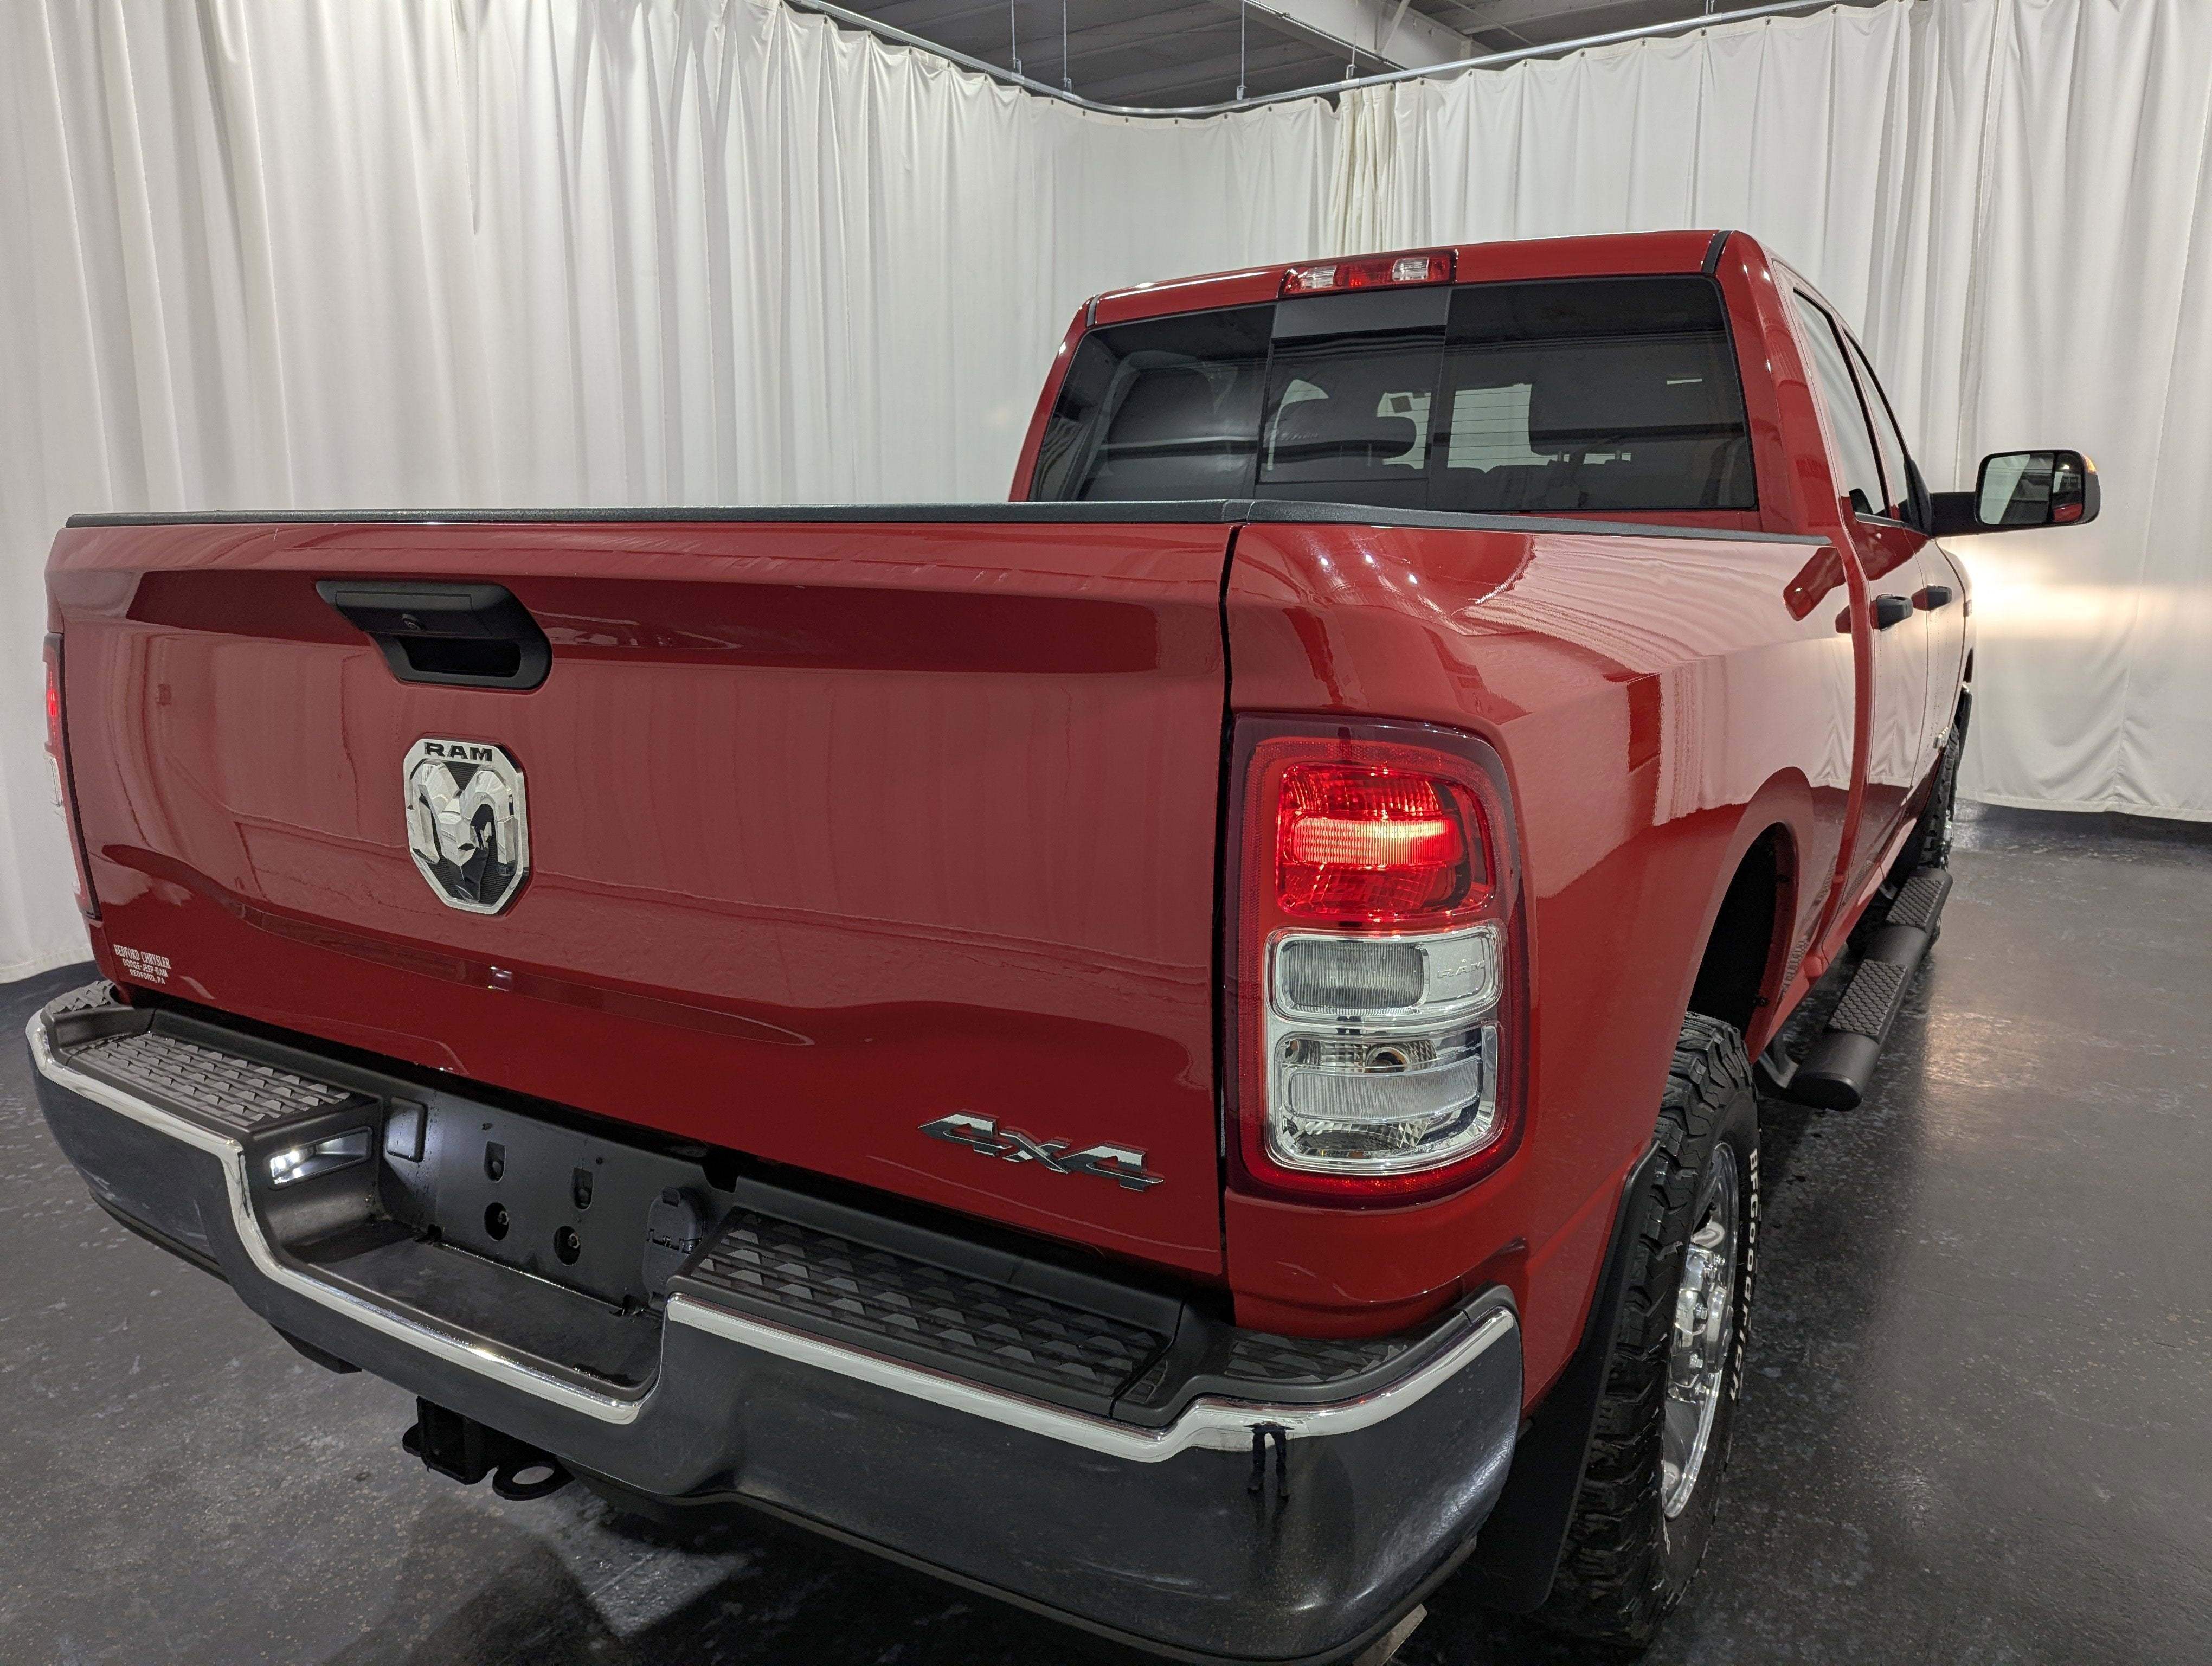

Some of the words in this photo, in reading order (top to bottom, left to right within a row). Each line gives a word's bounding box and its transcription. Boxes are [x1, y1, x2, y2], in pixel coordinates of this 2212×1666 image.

[424, 742, 493, 762] RAM
[113, 944, 140, 961] BEDFORD
[140, 951, 171, 970] CHRYSLER
[1437, 960, 1485, 979] RAM
[157, 976, 166, 985] PA
